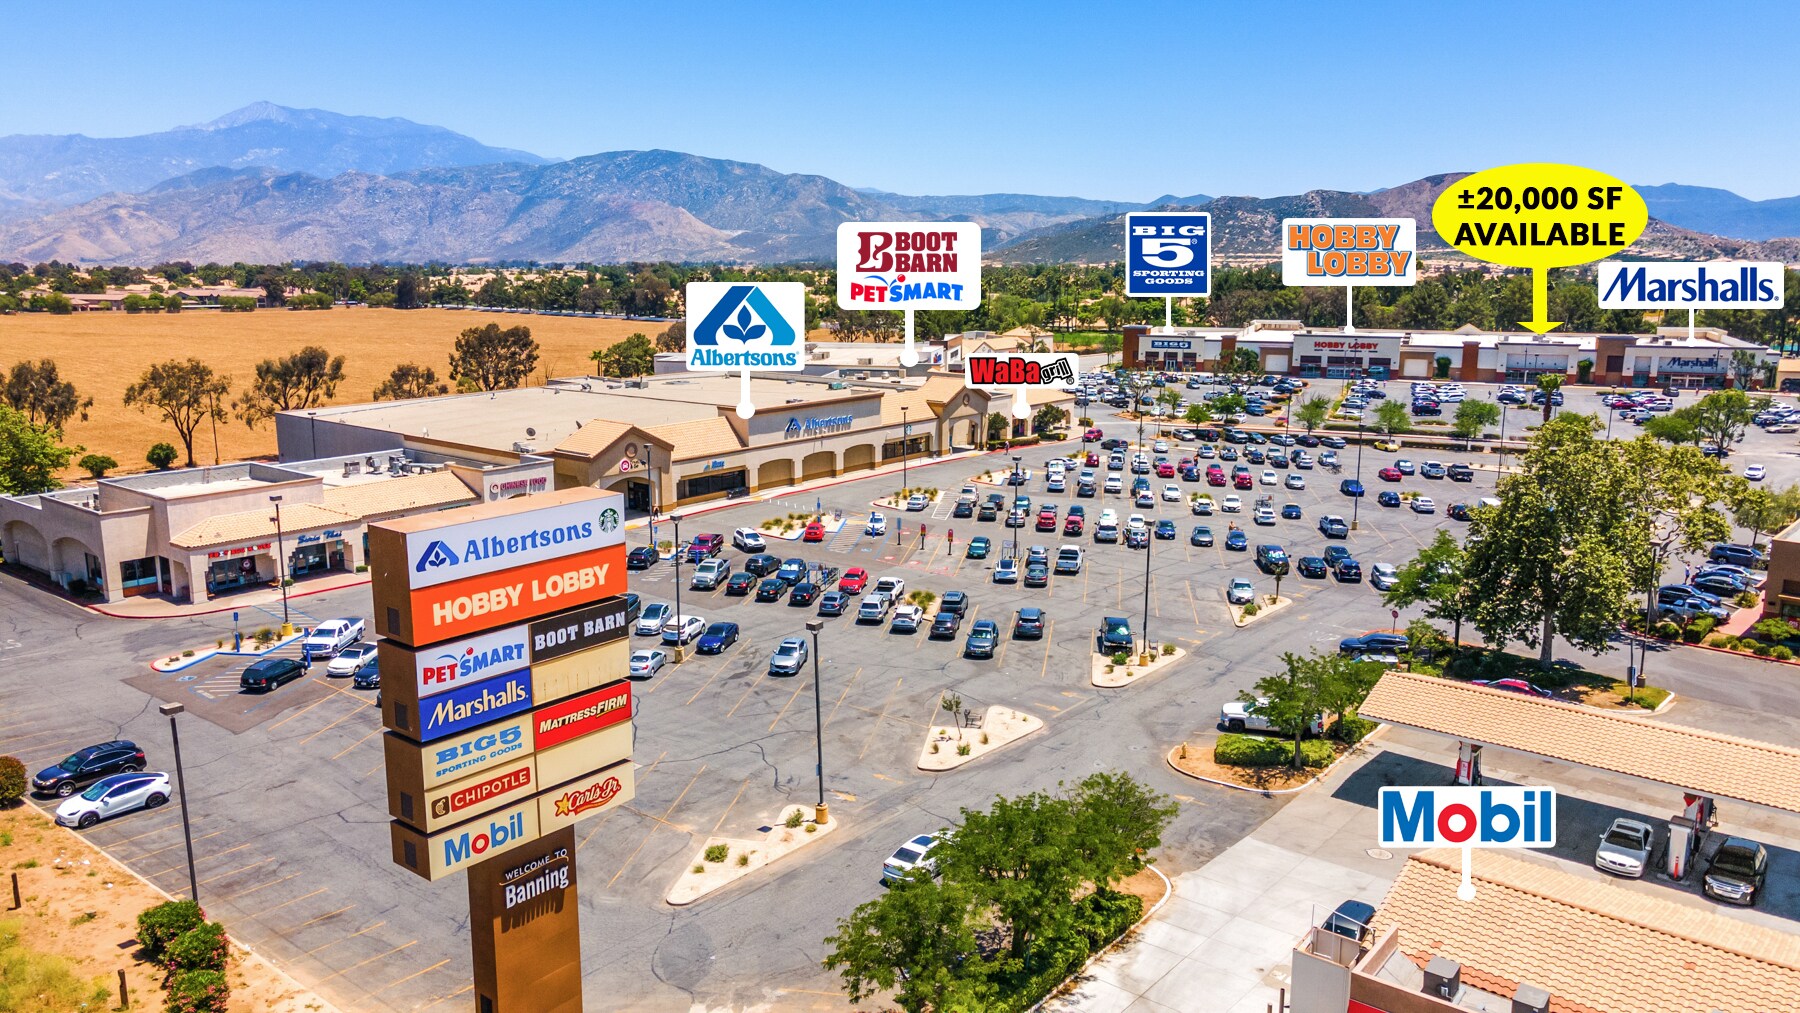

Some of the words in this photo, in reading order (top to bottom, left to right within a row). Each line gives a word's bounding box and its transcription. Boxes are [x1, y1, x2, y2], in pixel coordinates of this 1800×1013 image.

[1314, 341, 1346, 349] HOBBY
[1348, 342, 1379, 350] LOBBY
[1666, 357, 1719, 368] Marshalls
[463, 521, 592, 564] Albertsons
[432, 583, 524, 627] HOBBY
[531, 563, 610, 602] LOBBY
[534, 626, 579, 652] BOOT
[583, 611, 626, 637] BARN
[427, 683, 526, 730] Marshalls
[435, 755, 487, 778] SPORTING
[489, 742, 523, 759] GOODS
[454, 771, 528, 807] CHIPOTLE
[568, 783, 601, 811] Carl's
[444, 811, 524, 867] Mobil
[505, 855, 550, 880] WELCOME
[554, 848, 568, 859] TO
[505, 865, 569, 909] Banning
